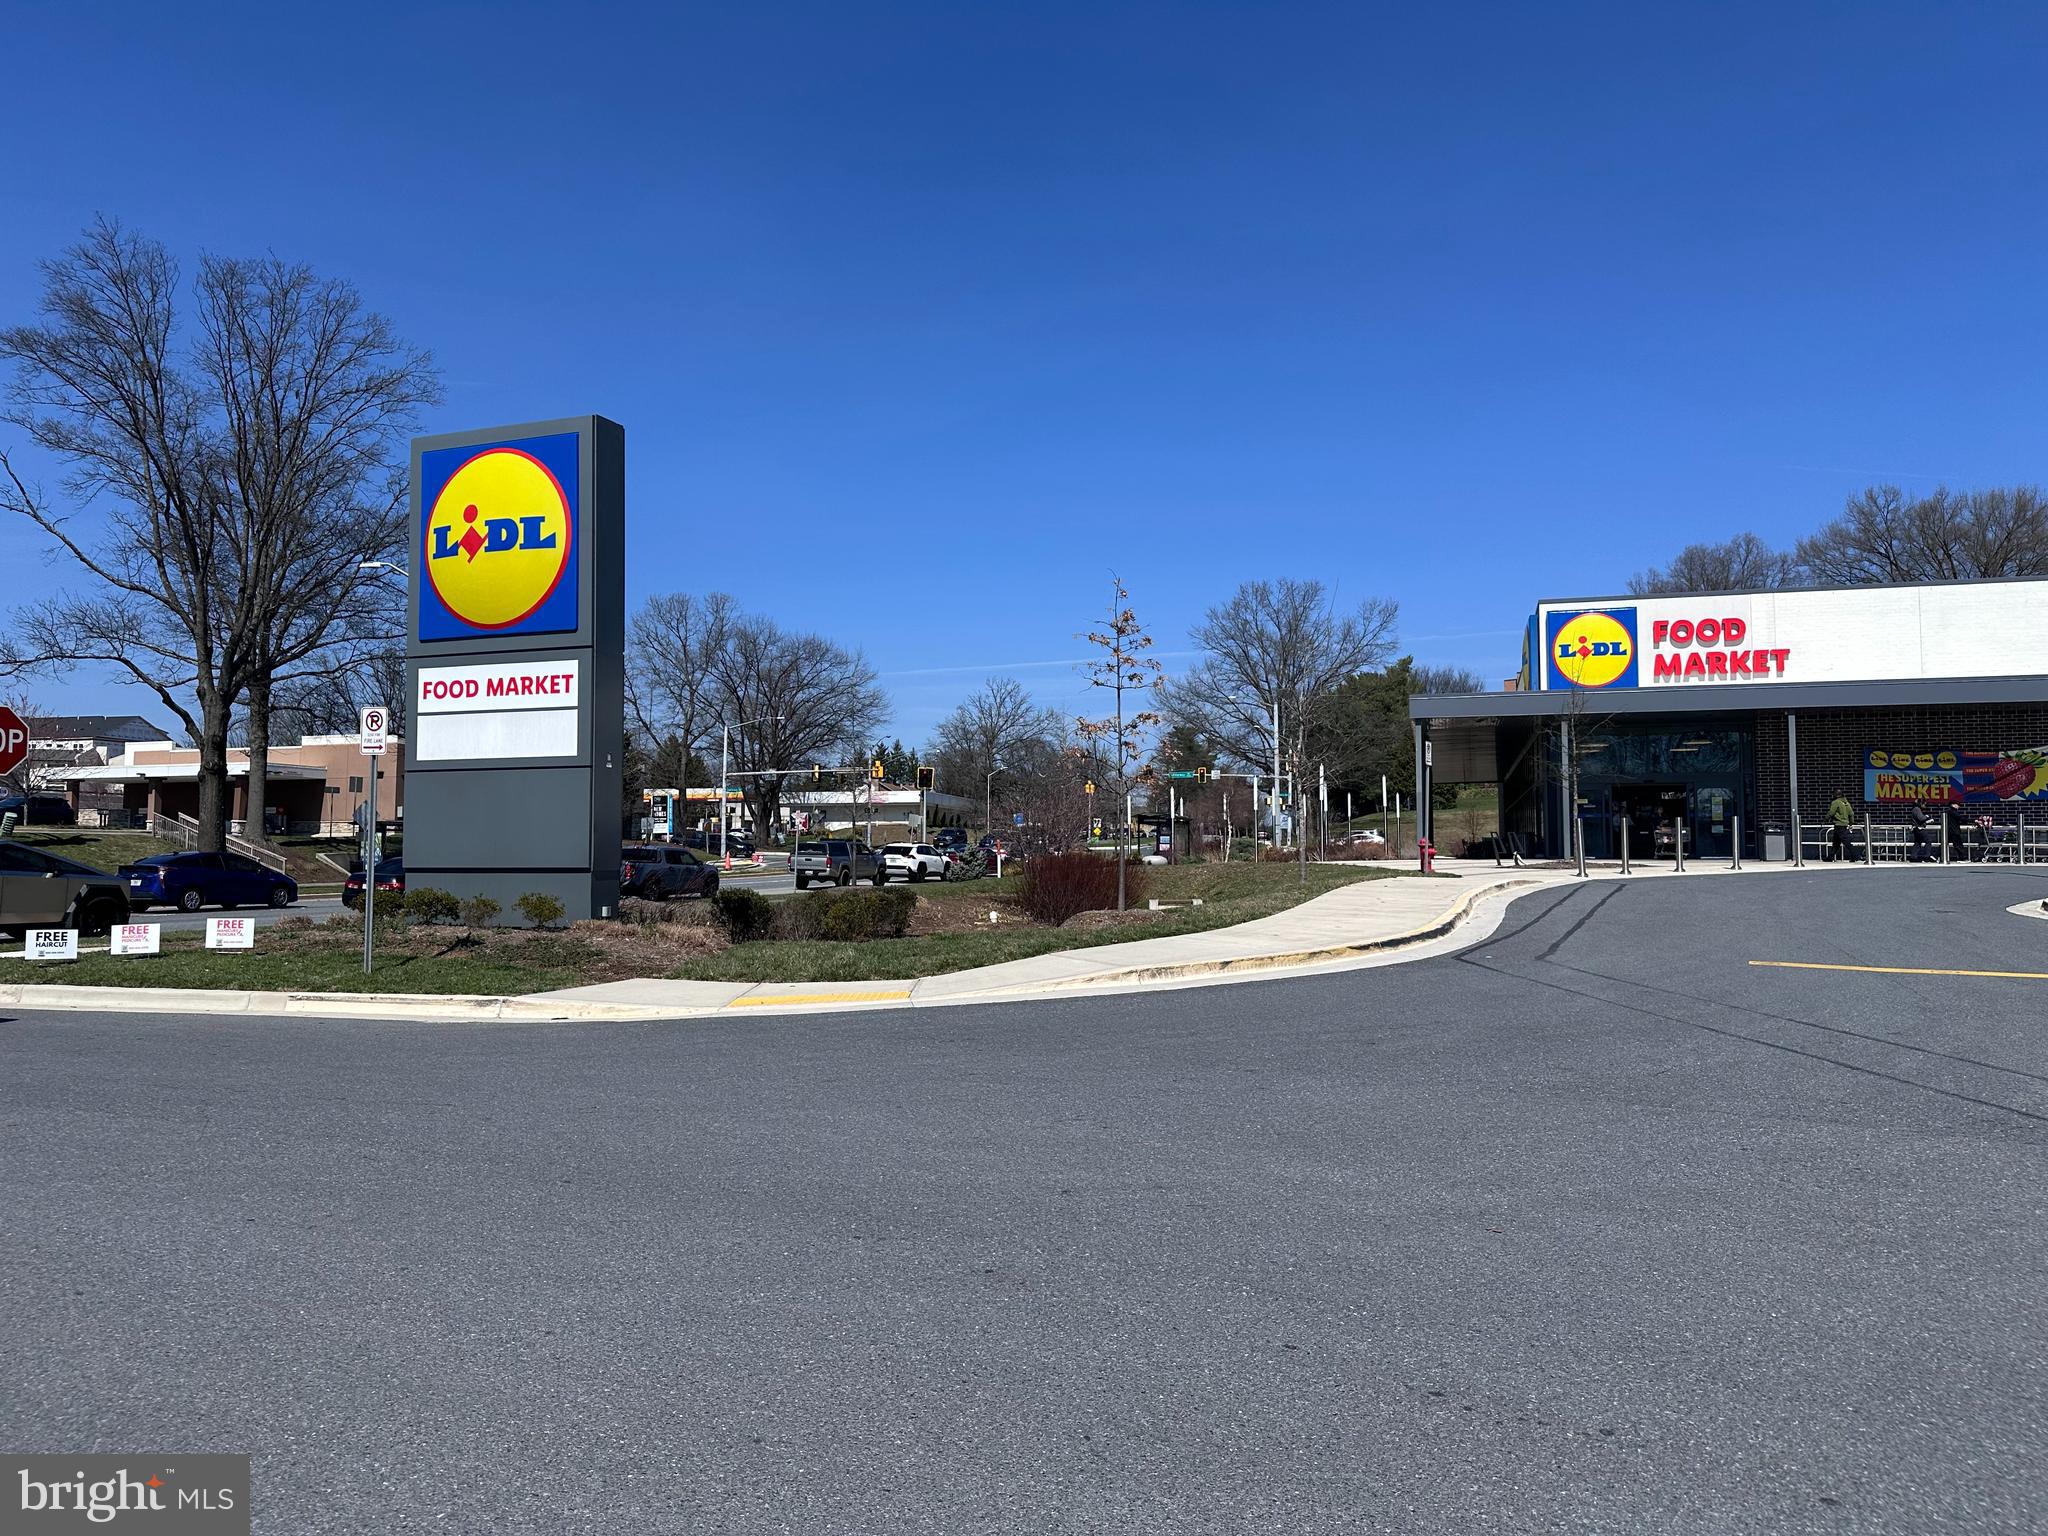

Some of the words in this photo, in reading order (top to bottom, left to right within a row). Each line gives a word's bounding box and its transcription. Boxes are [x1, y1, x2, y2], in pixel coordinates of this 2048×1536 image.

[1653, 618, 1746, 645] FOOD
[1653, 649, 1790, 678] MARKET
[423, 679, 479, 700] FOOD
[486, 674, 574, 697] MARKET
[1877, 774, 1895, 783] THE
[1875, 783, 1952, 799] MARKET
[122, 925, 149, 935] FREE
[217, 920, 244, 928] FREE
[36, 932, 68, 941] FREE
